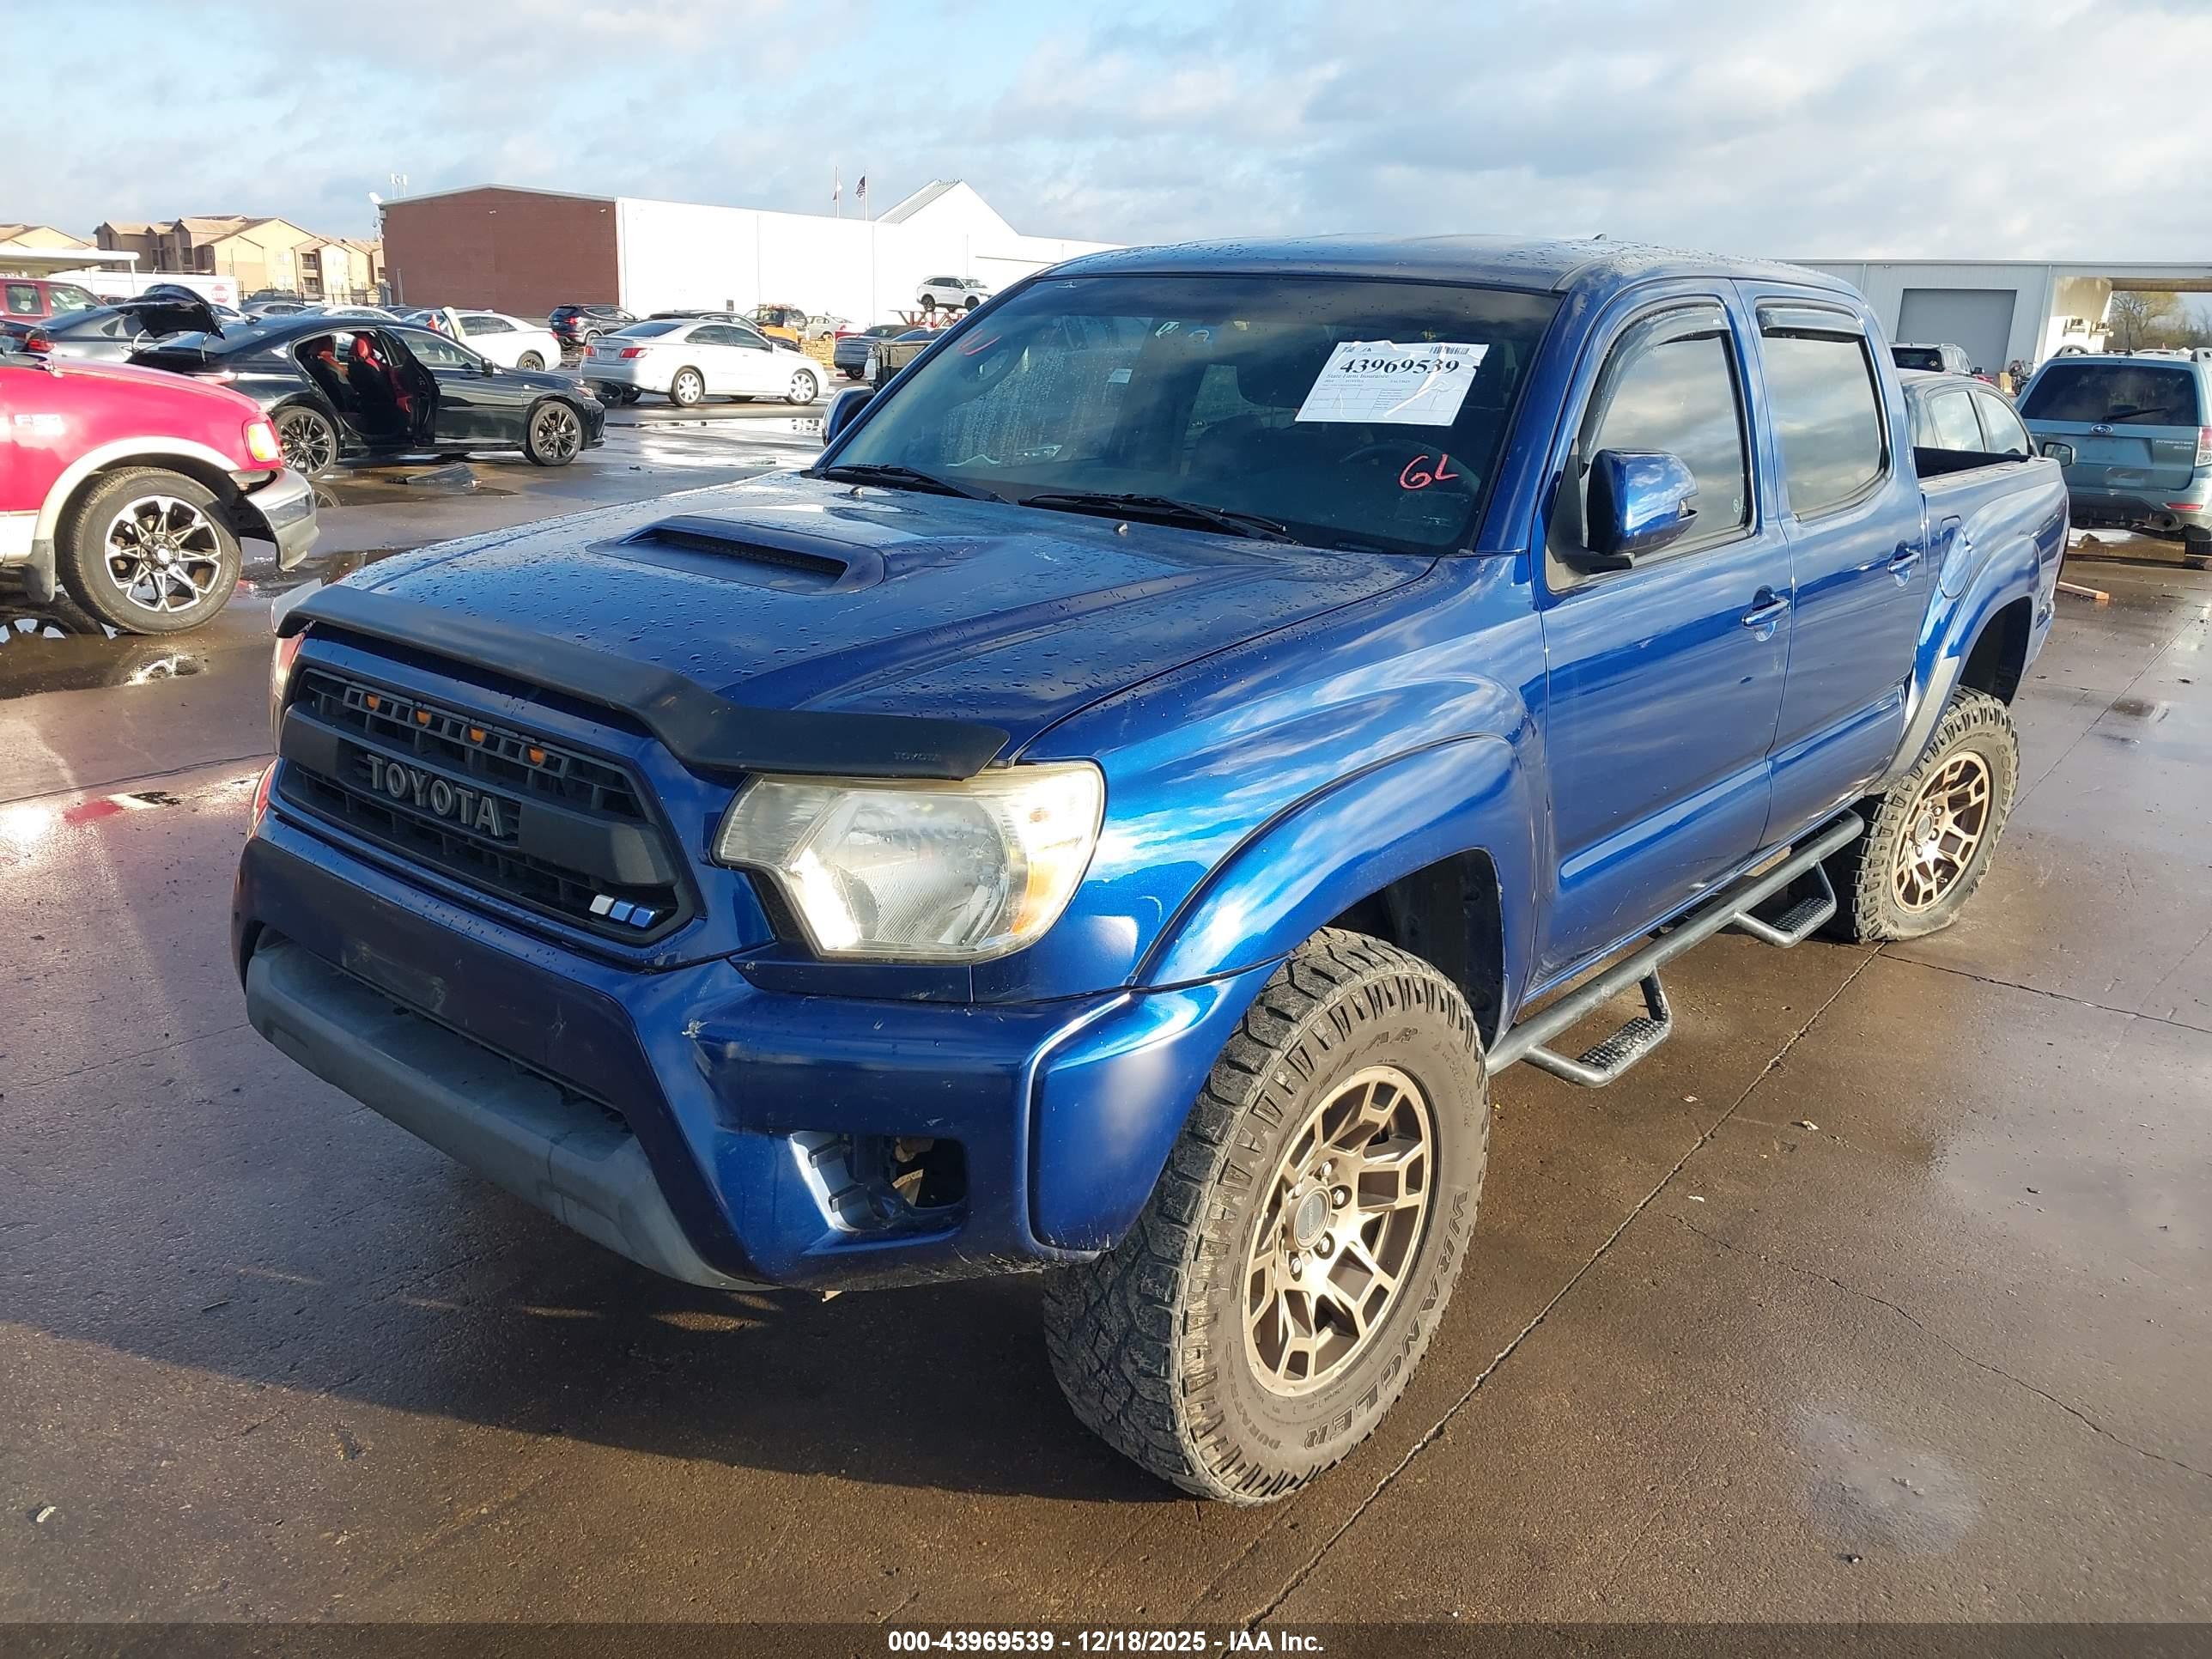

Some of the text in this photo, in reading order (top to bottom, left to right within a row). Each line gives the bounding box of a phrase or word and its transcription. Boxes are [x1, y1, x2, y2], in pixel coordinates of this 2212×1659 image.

[1340, 358, 1460, 374] 43969539
[367, 753, 505, 838] TOYOTA
[1304, 1190, 1469, 1450] WRANGLER
